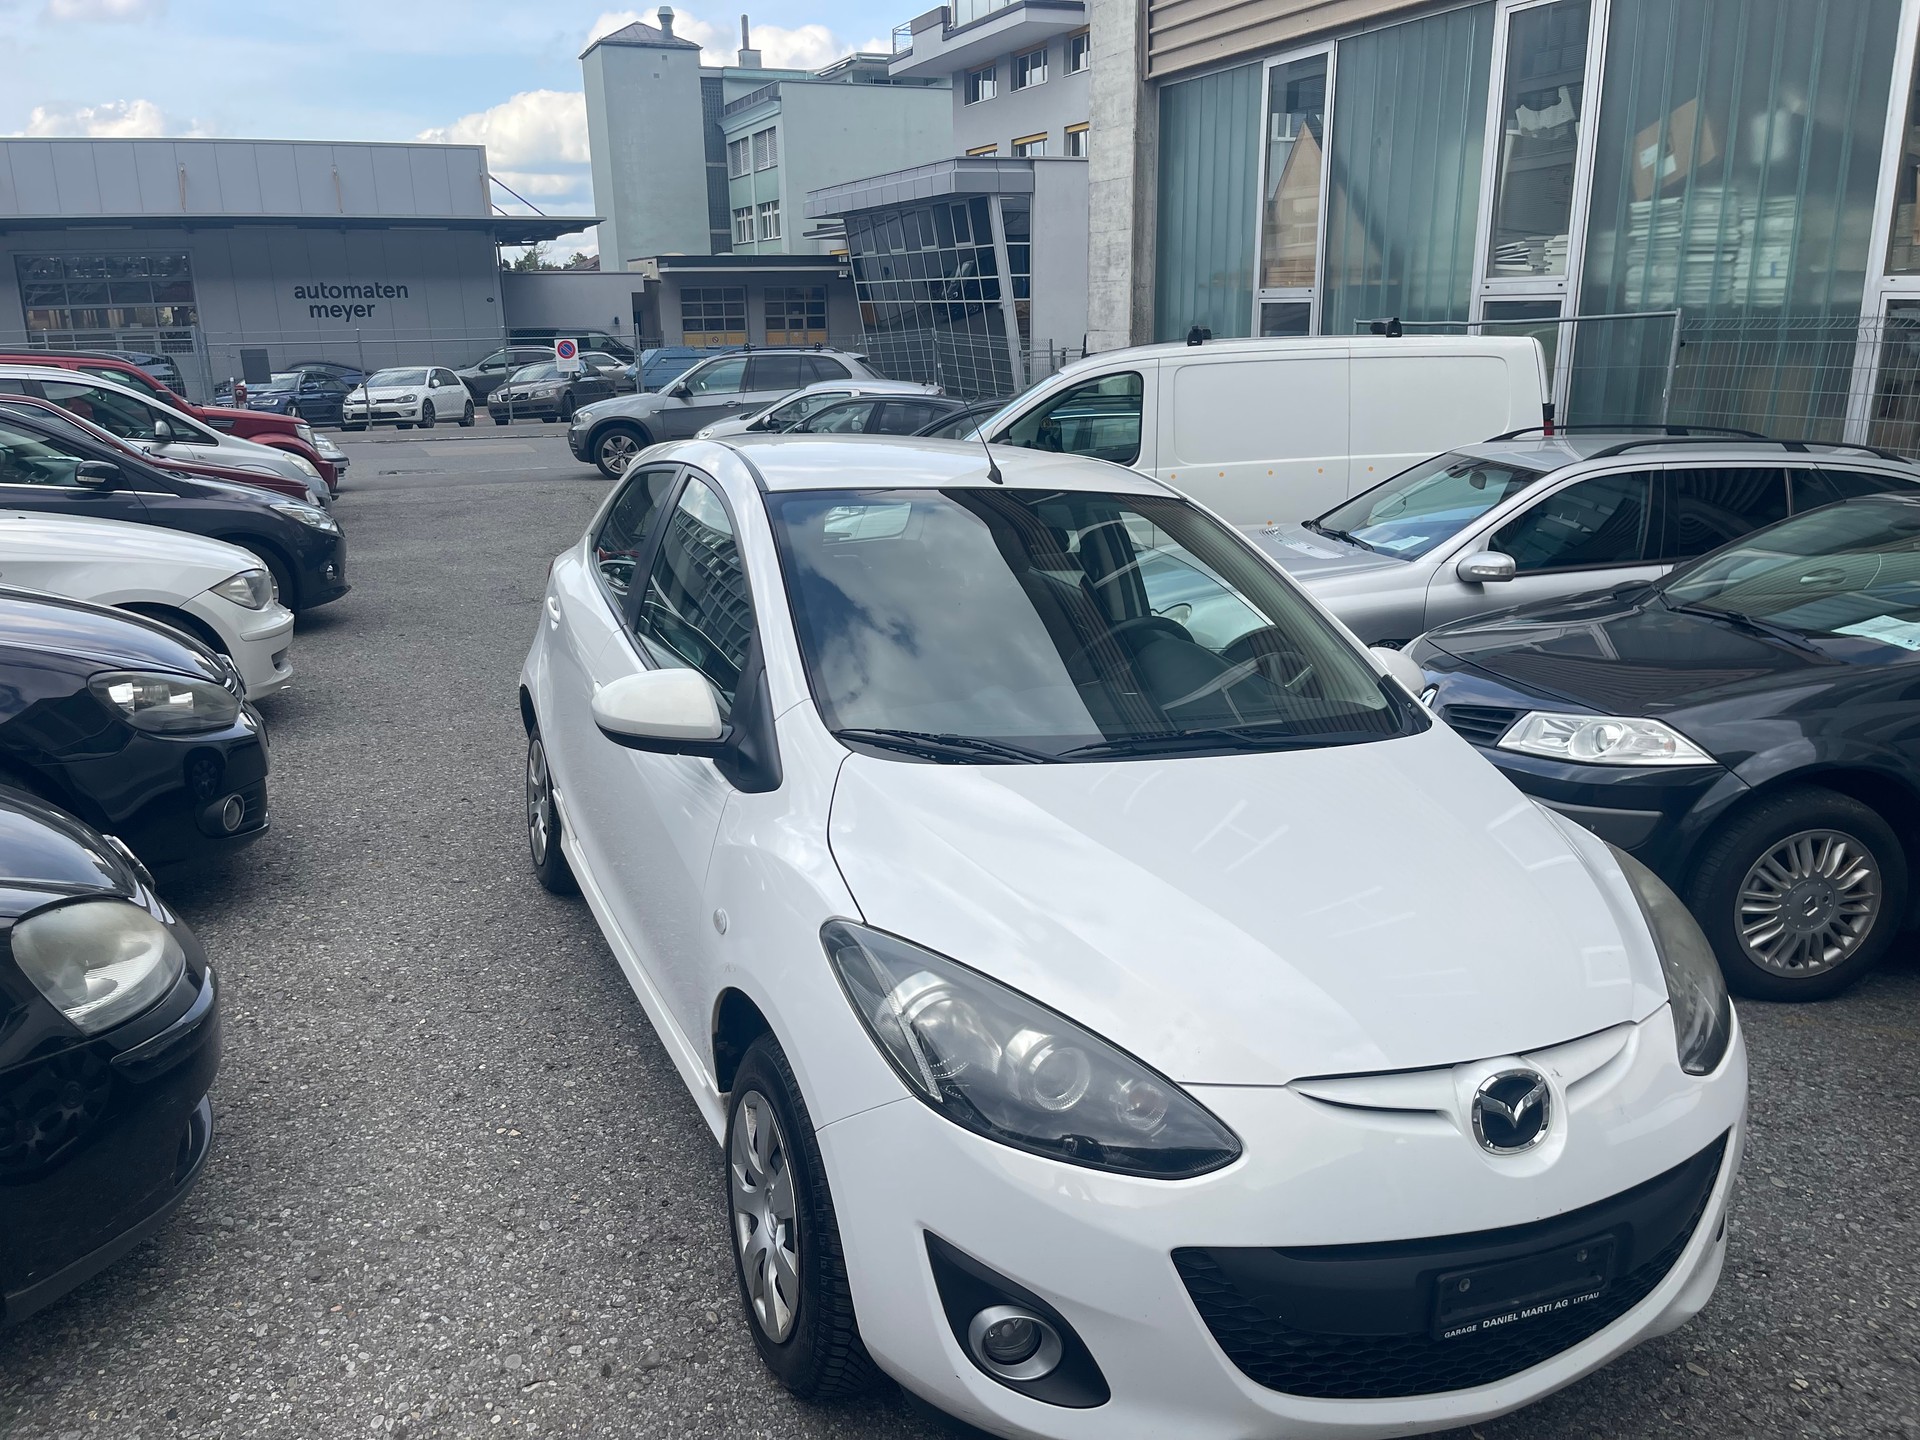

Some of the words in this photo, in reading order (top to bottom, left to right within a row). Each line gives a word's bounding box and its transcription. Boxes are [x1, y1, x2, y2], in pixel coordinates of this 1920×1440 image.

[294, 282, 408, 299] automaten
[309, 304, 375, 322] meyer
[1445, 1324, 1477, 1338] GARAGE
[1482, 1314, 1518, 1328] DANIEL
[1521, 1304, 1552, 1318] MARTI
[1554, 1299, 1568, 1310] AG
[1573, 1292, 1600, 1304] LITTAU
